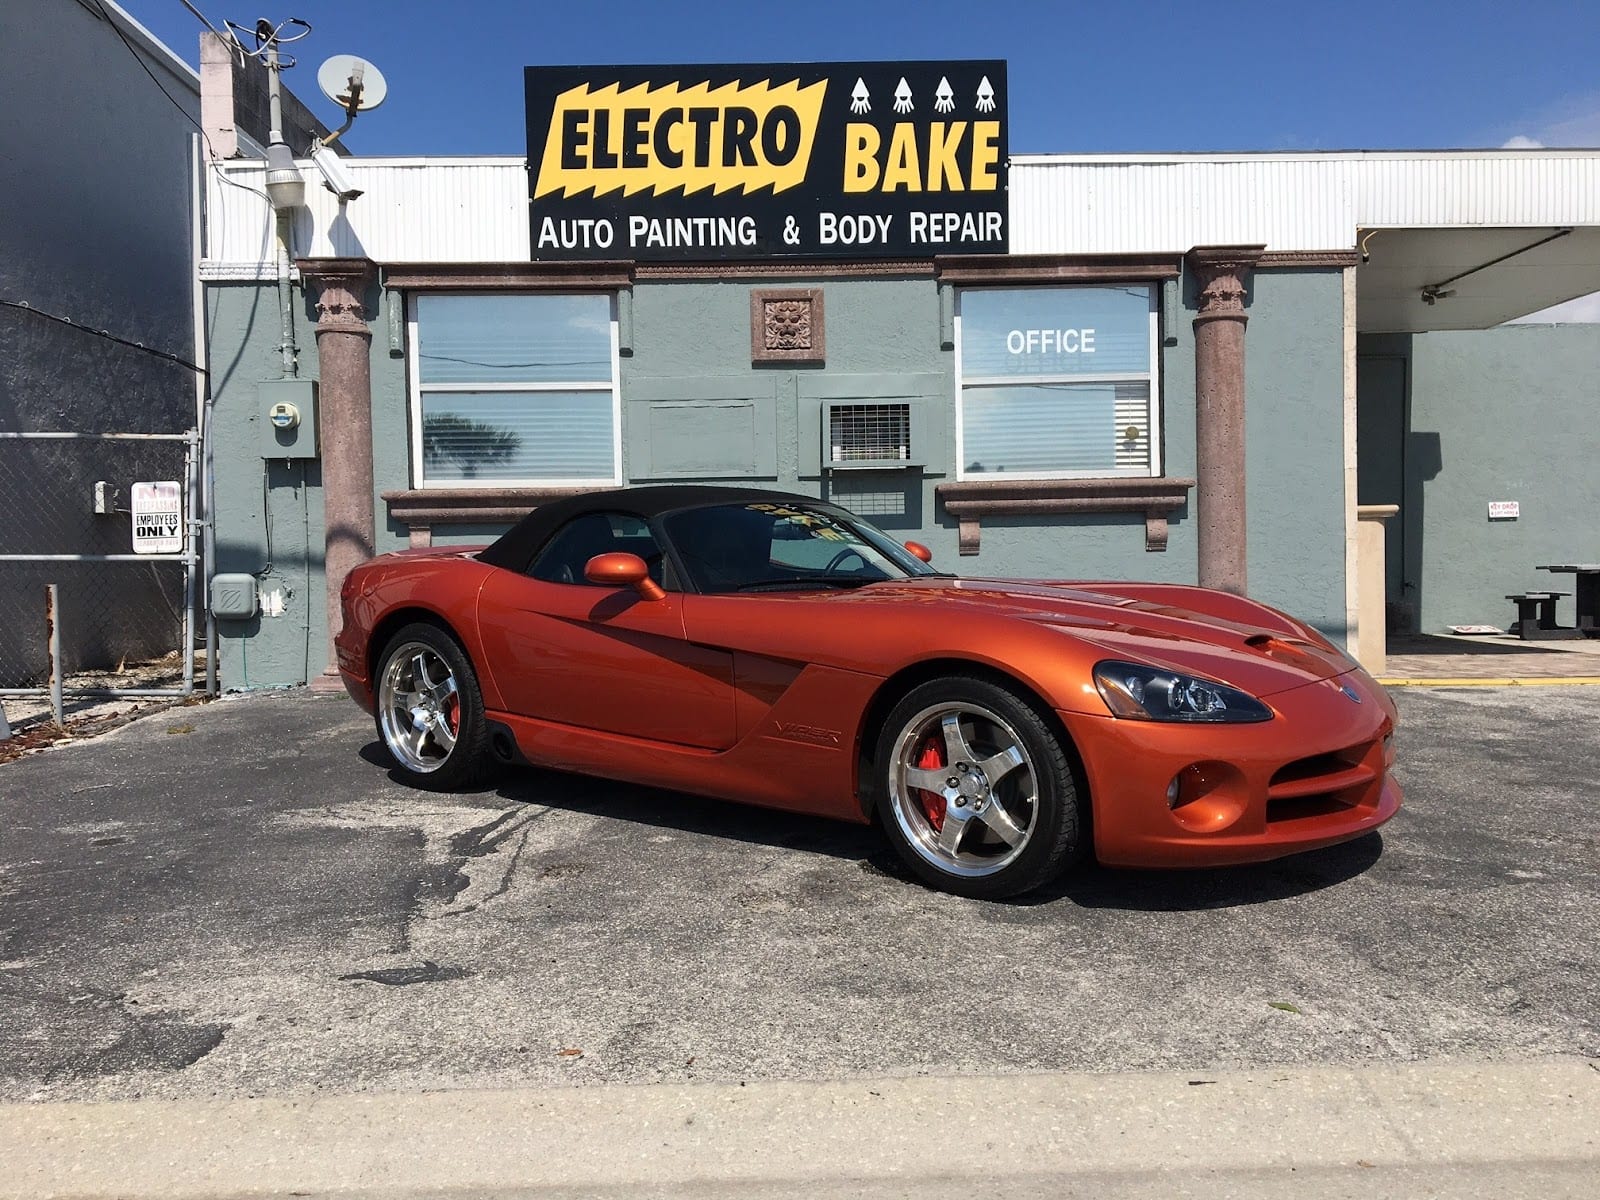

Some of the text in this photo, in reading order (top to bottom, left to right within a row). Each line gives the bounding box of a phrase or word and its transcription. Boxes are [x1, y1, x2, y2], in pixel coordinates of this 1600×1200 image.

[560, 105, 1001, 193] ELECTRO BAKE
[537, 211, 1003, 249] AUTO PAINTING & BODY REPAIR
[1006, 328, 1096, 354] OFFICE
[136, 514, 178, 526] EMPLOYEES
[136, 526, 178, 537] ONLY
